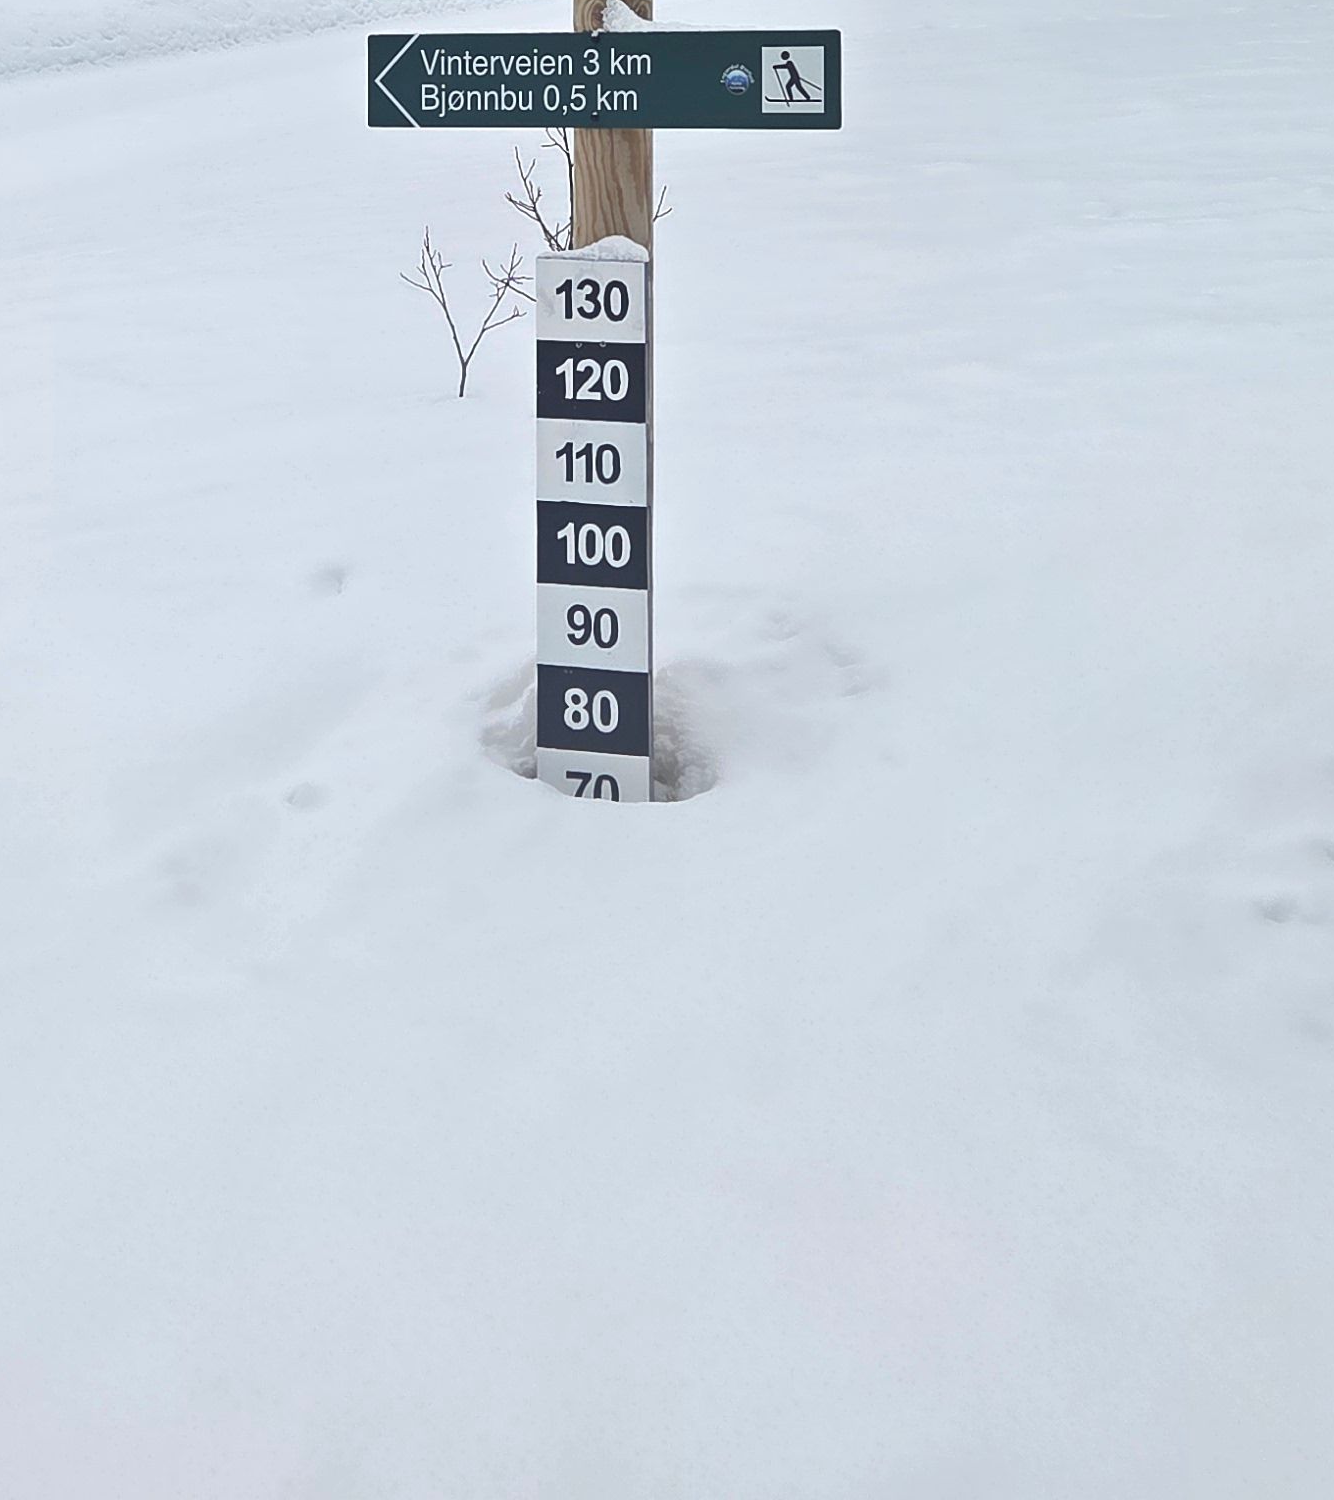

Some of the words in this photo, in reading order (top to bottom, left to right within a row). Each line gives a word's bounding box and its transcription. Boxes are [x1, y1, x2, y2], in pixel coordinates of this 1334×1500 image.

[420, 48, 573, 76] Vinterveien
[582, 48, 600, 76] 3
[610, 47, 651, 75] km
[420, 83, 533, 117] Bjønnbu
[543, 84, 586, 115] 0,5
[597, 83, 638, 111] km
[555, 277, 630, 322] 130
[554, 359, 629, 402] 120
[554, 441, 621, 485] 110
[555, 523, 631, 569] 100
[566, 603, 620, 650] 90
[563, 687, 620, 734] 80
[566, 770, 620, 802] 70
